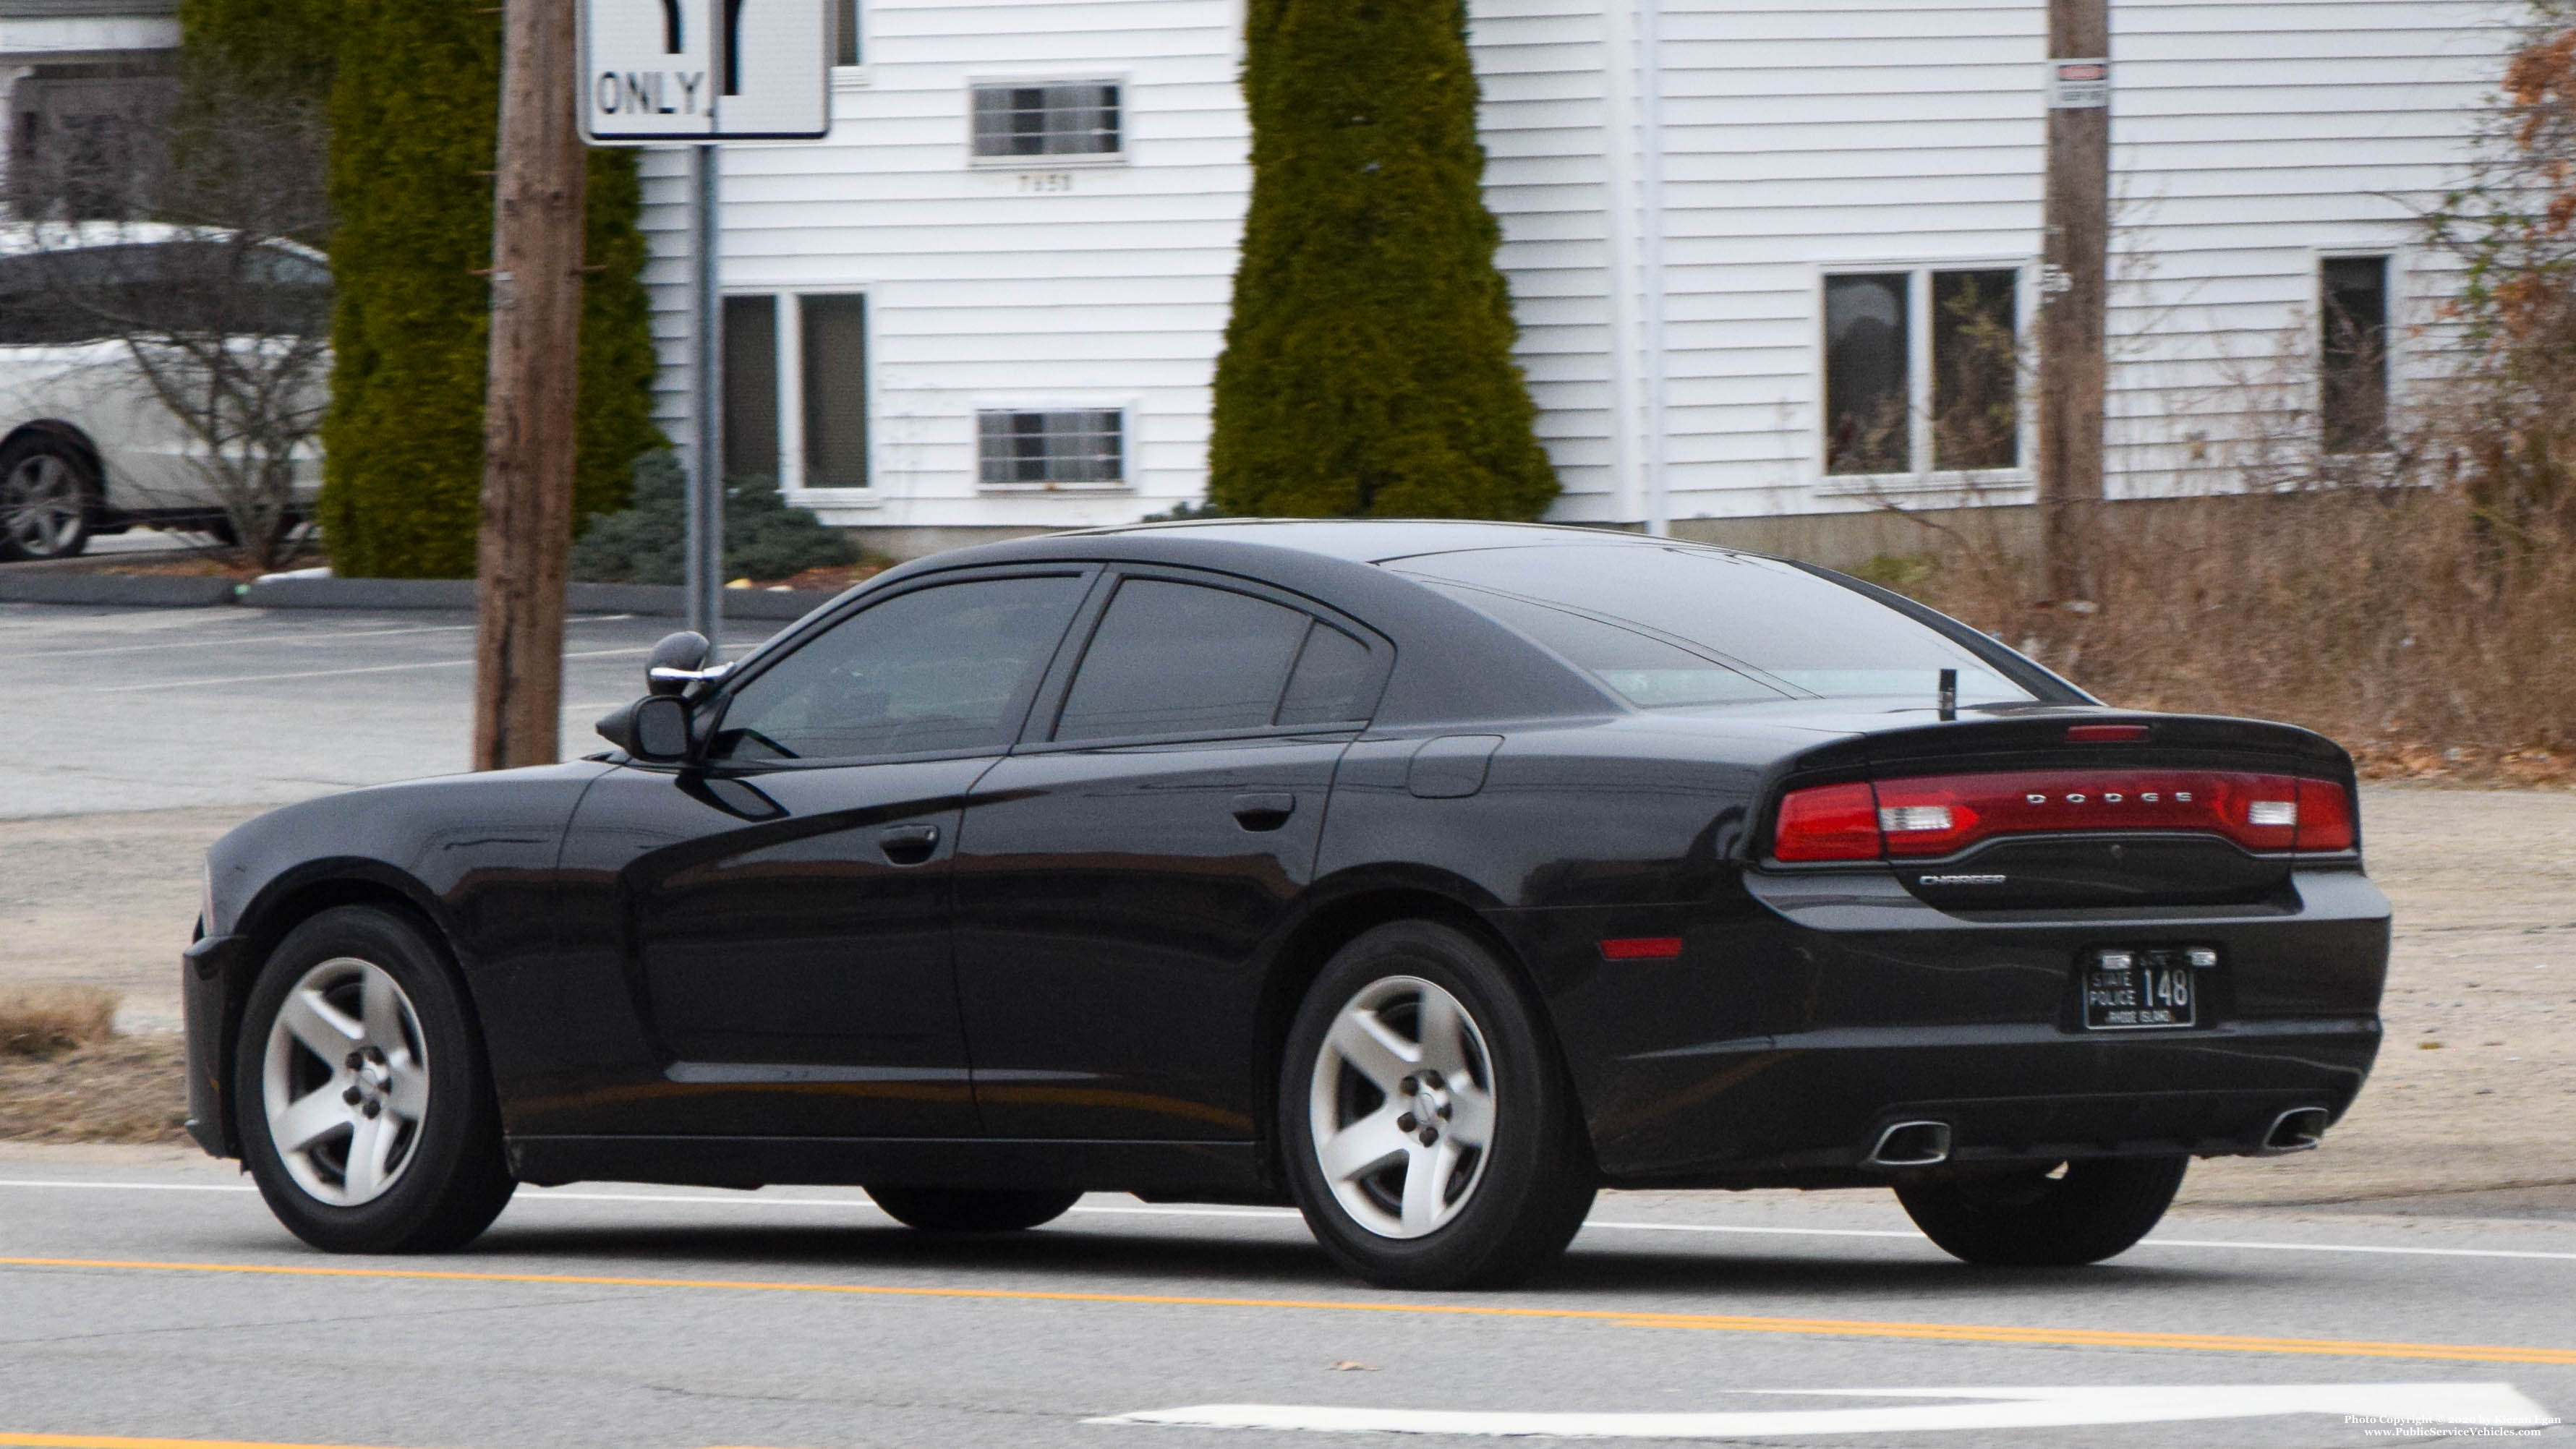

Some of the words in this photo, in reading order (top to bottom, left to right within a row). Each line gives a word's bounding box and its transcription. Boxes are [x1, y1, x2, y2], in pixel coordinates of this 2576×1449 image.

[596, 71, 704, 115] ONLY
[2026, 791, 2193, 804] DODGE
[1919, 874, 2007, 885] CHARGER
[2144, 969, 2188, 1006] 148
[2089, 990, 2137, 1006] POLICE
